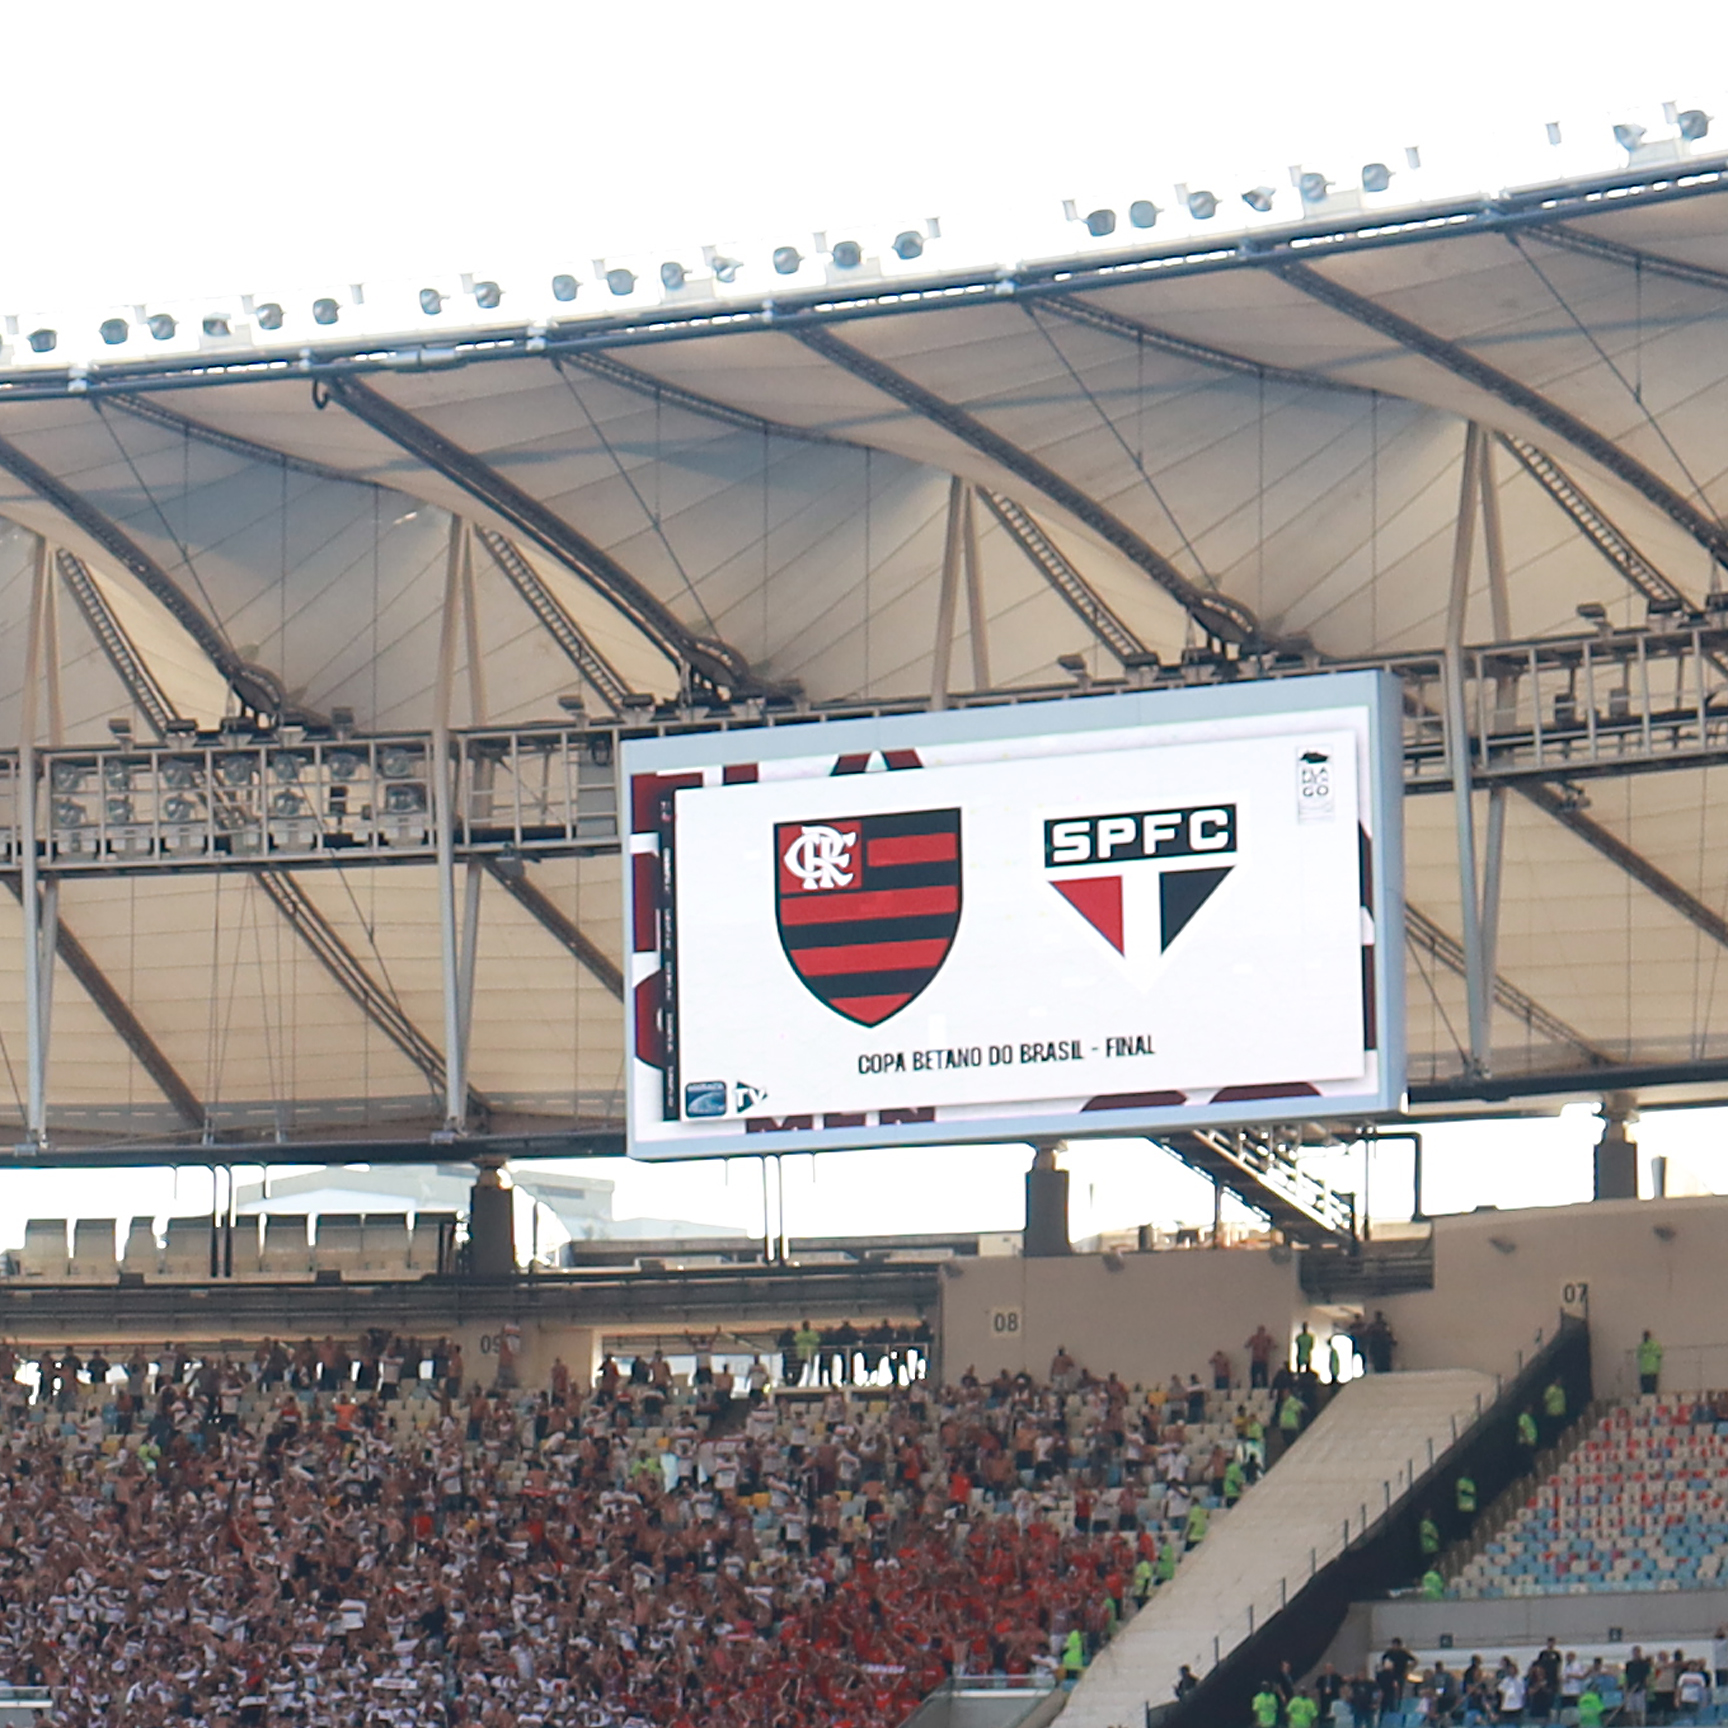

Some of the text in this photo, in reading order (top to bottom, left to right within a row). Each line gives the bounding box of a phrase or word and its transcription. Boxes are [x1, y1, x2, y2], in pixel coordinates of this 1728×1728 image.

[1052, 808, 1230, 862] SPFC
[858, 1053, 906, 1074] COPA
[913, 1047, 982, 1072] BETANO
[989, 1045, 1013, 1066] DO
[1020, 1040, 1084, 1064] BRASIL
[1106, 1034, 1155, 1058] FINAL
[1564, 1283, 1589, 1303] 07
[995, 1312, 1018, 1332] 08
